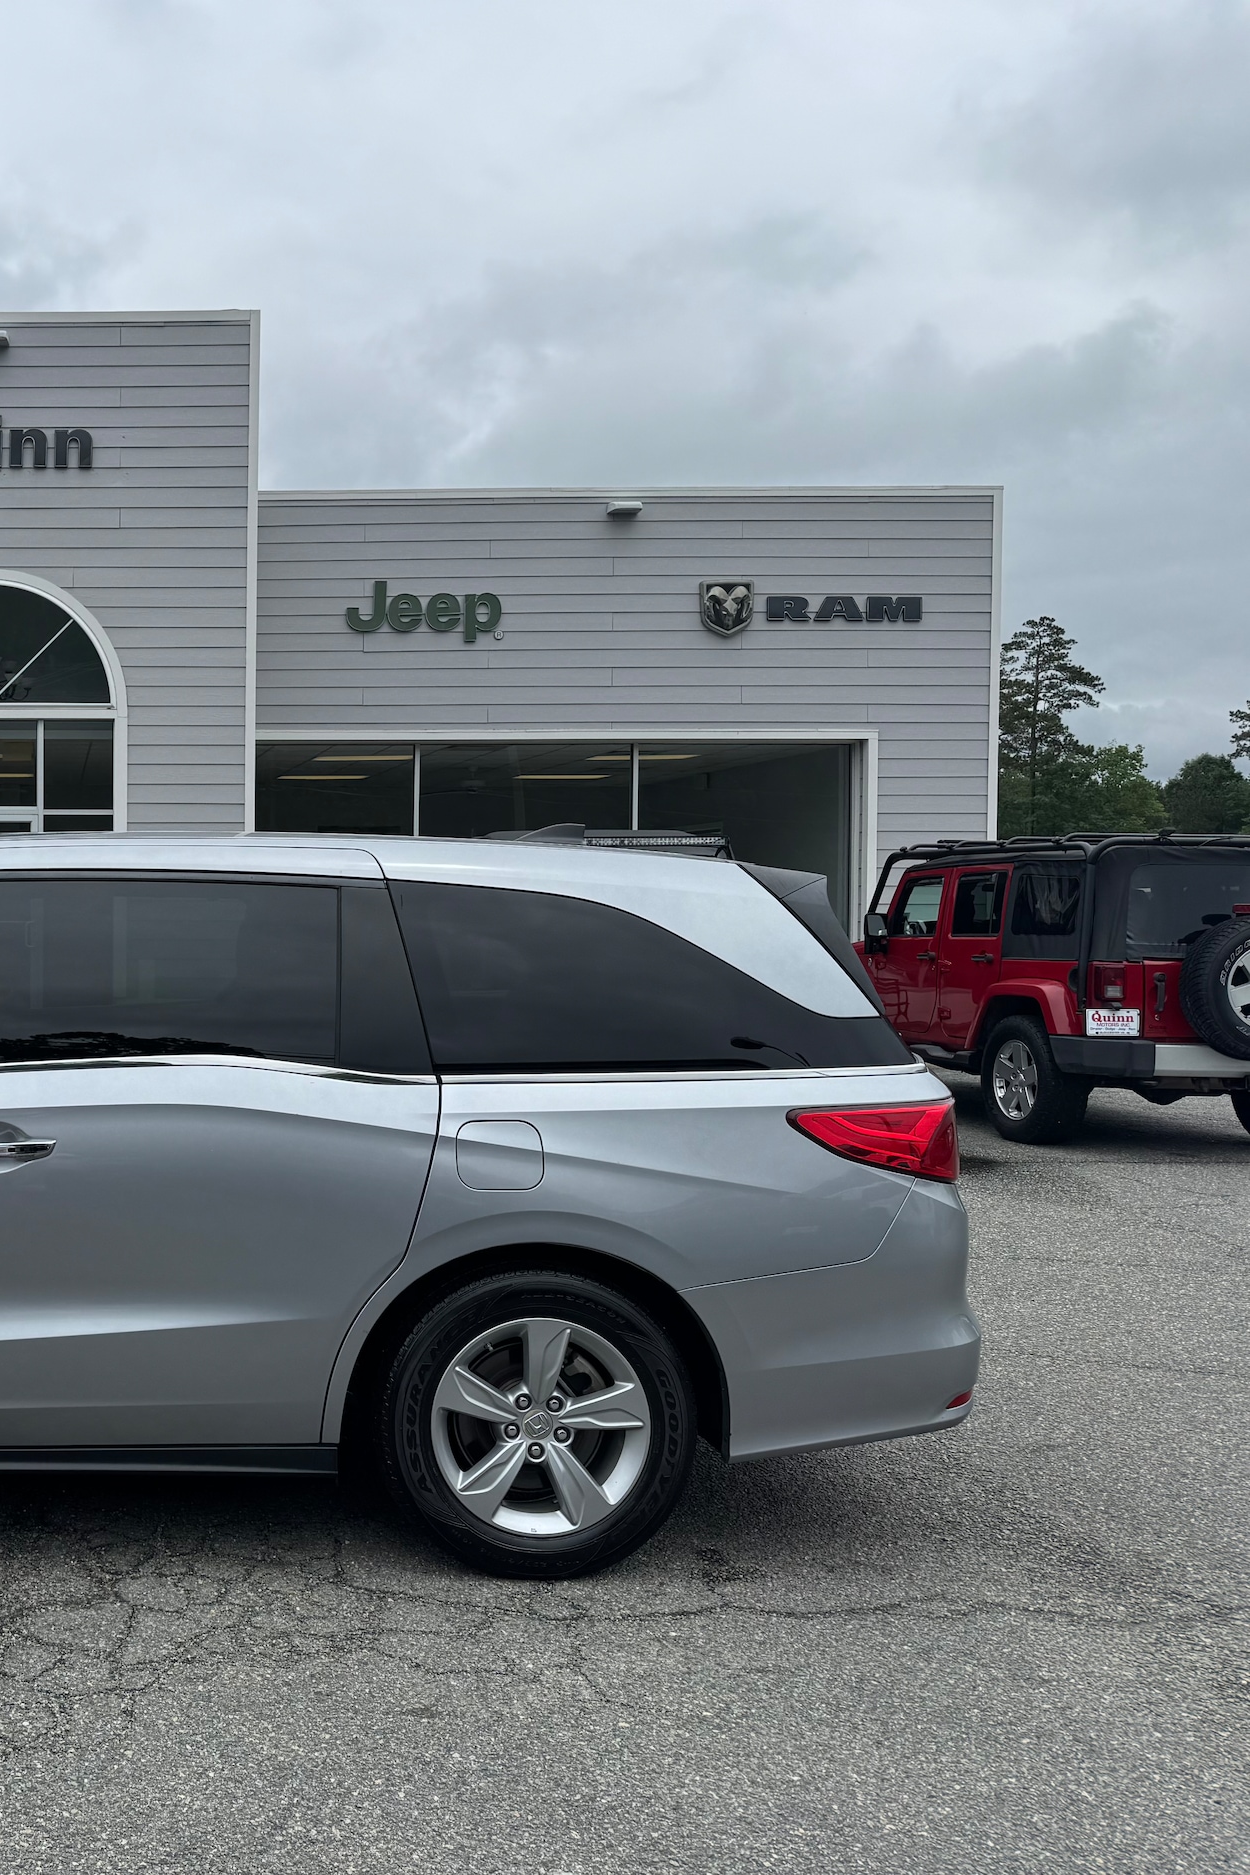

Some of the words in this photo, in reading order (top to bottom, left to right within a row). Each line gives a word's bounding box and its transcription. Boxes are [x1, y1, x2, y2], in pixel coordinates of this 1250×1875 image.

[346, 580, 502, 643] Jeep
[767, 596, 923, 622] RAM
[1091, 1012, 1134, 1023] Quinn
